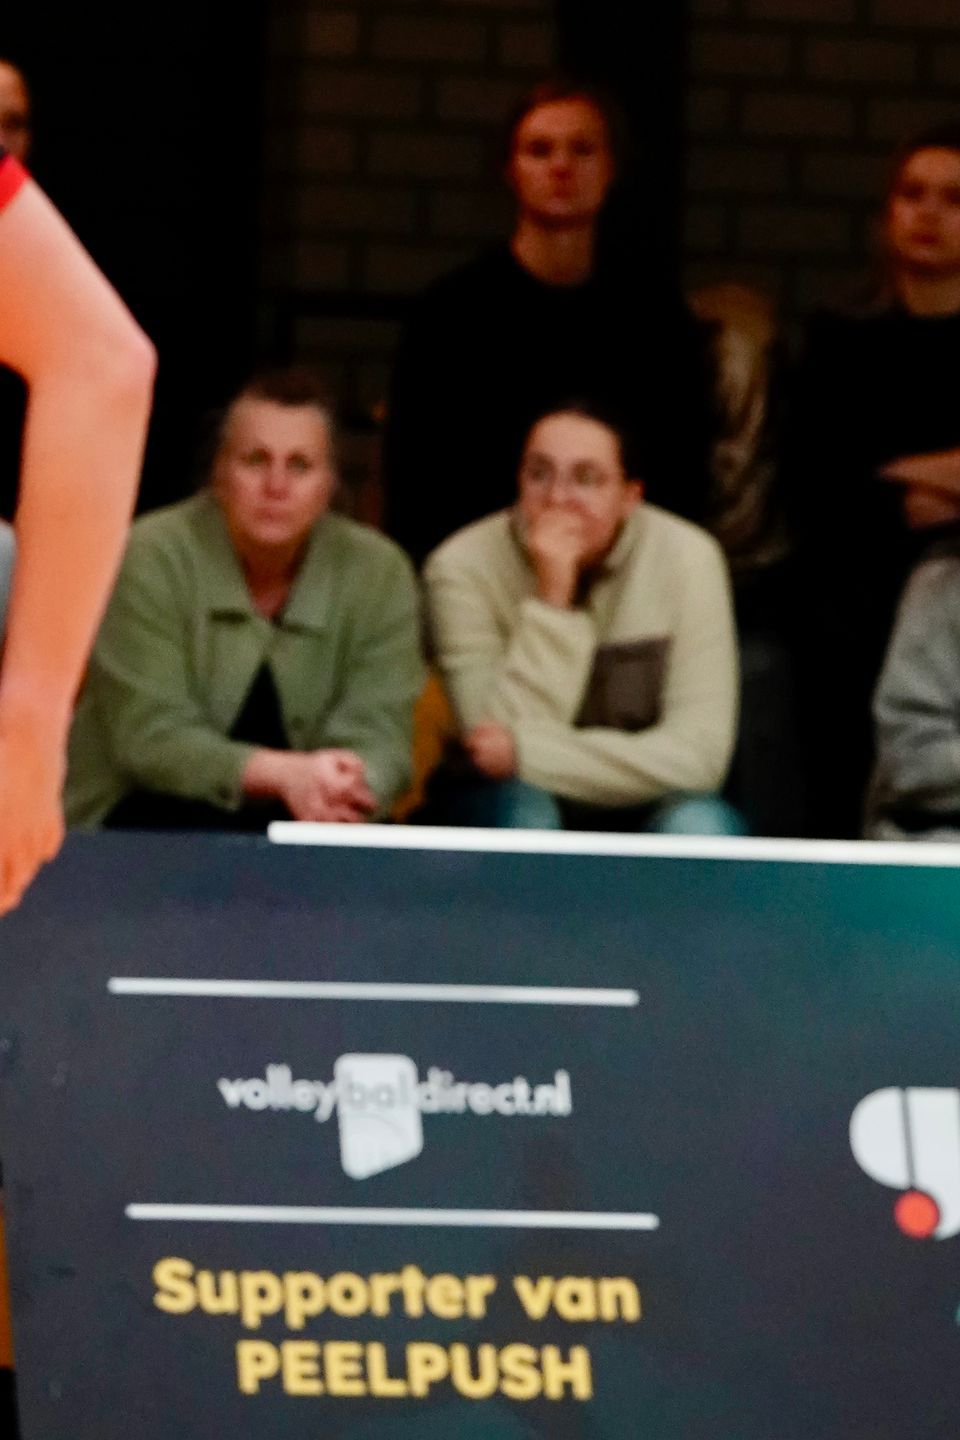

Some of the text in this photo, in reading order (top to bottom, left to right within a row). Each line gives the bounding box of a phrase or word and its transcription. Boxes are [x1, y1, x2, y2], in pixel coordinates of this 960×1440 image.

[153, 1257, 643, 1330] Supporter van
[236, 1339, 594, 1401] PEELPUSH
